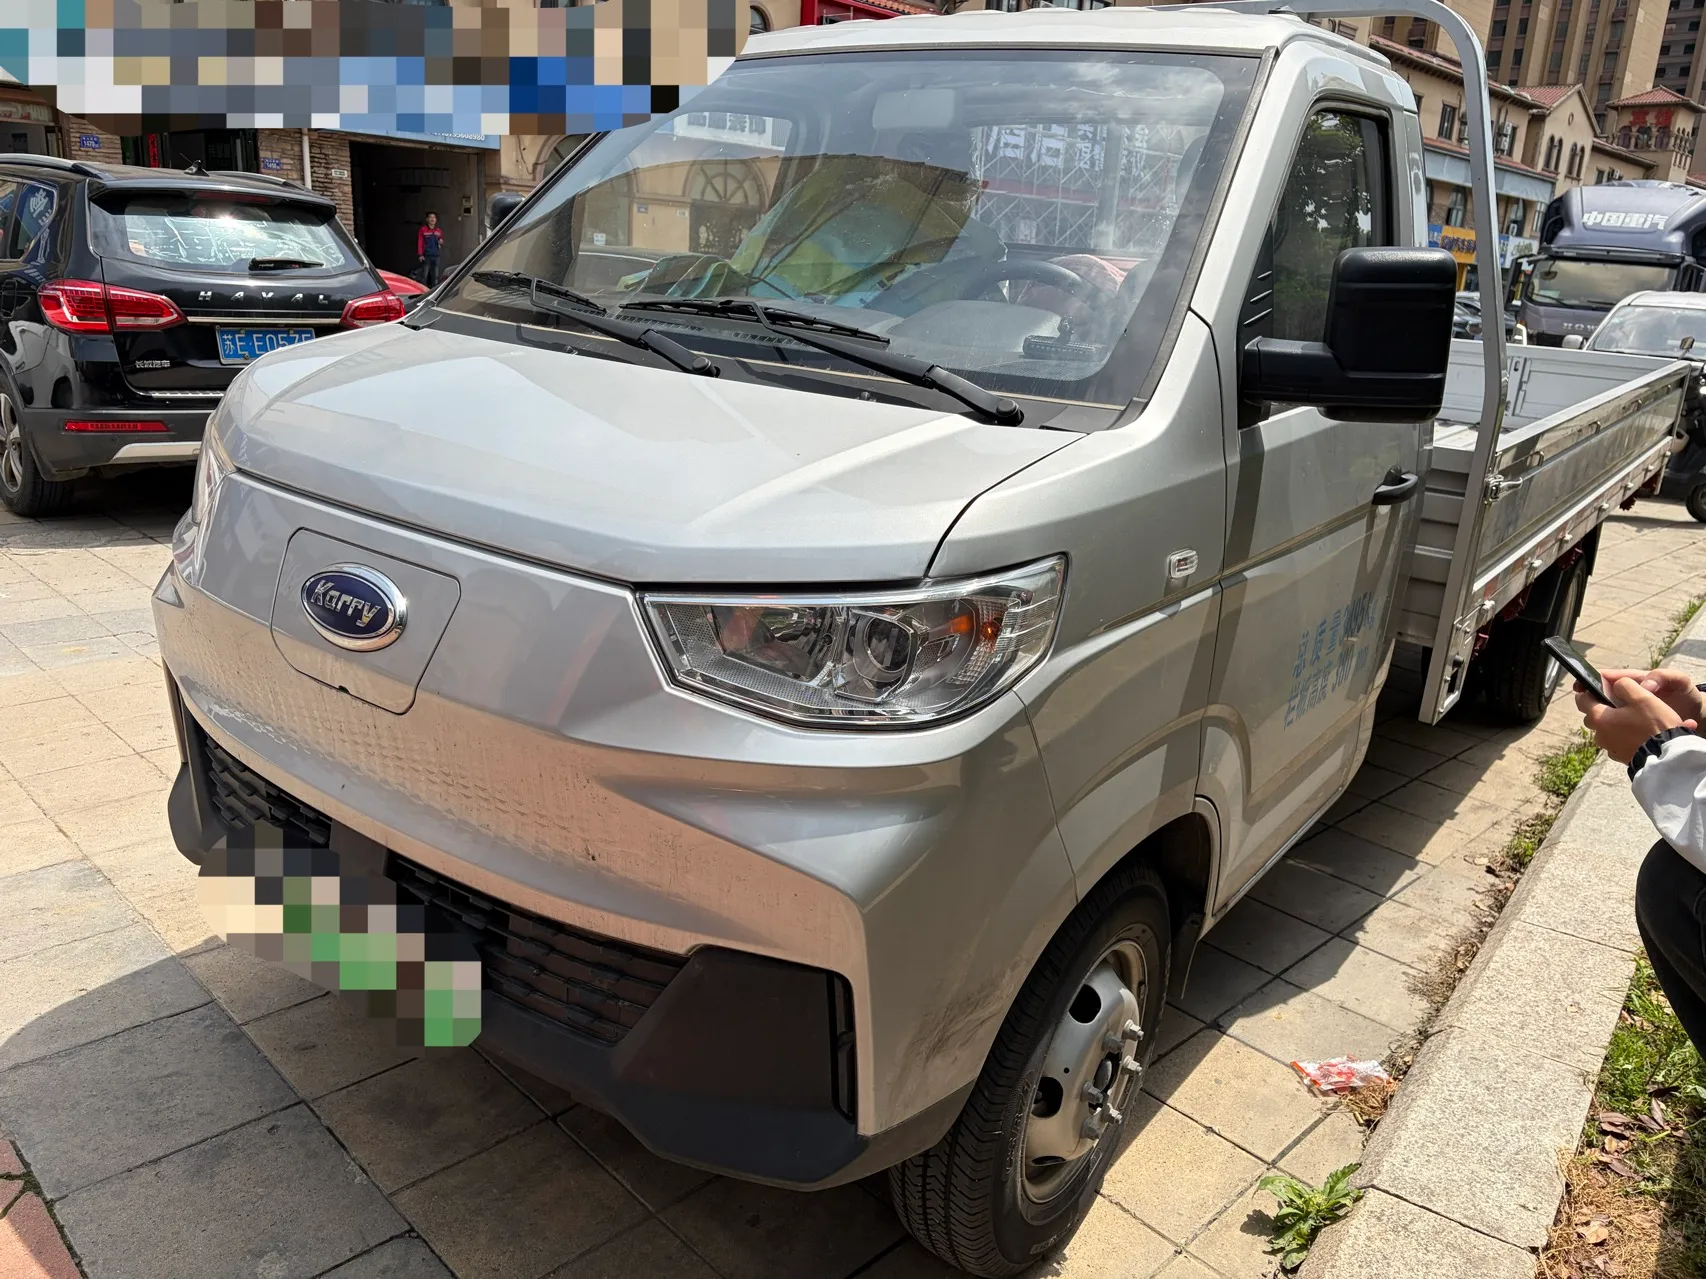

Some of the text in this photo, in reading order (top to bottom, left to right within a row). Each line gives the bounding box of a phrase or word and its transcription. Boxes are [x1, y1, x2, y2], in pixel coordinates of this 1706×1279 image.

[1582, 211, 1668, 230] 中国重汽
[198, 291, 328, 304] HAVAL
[310, 580, 381, 627] Karry
